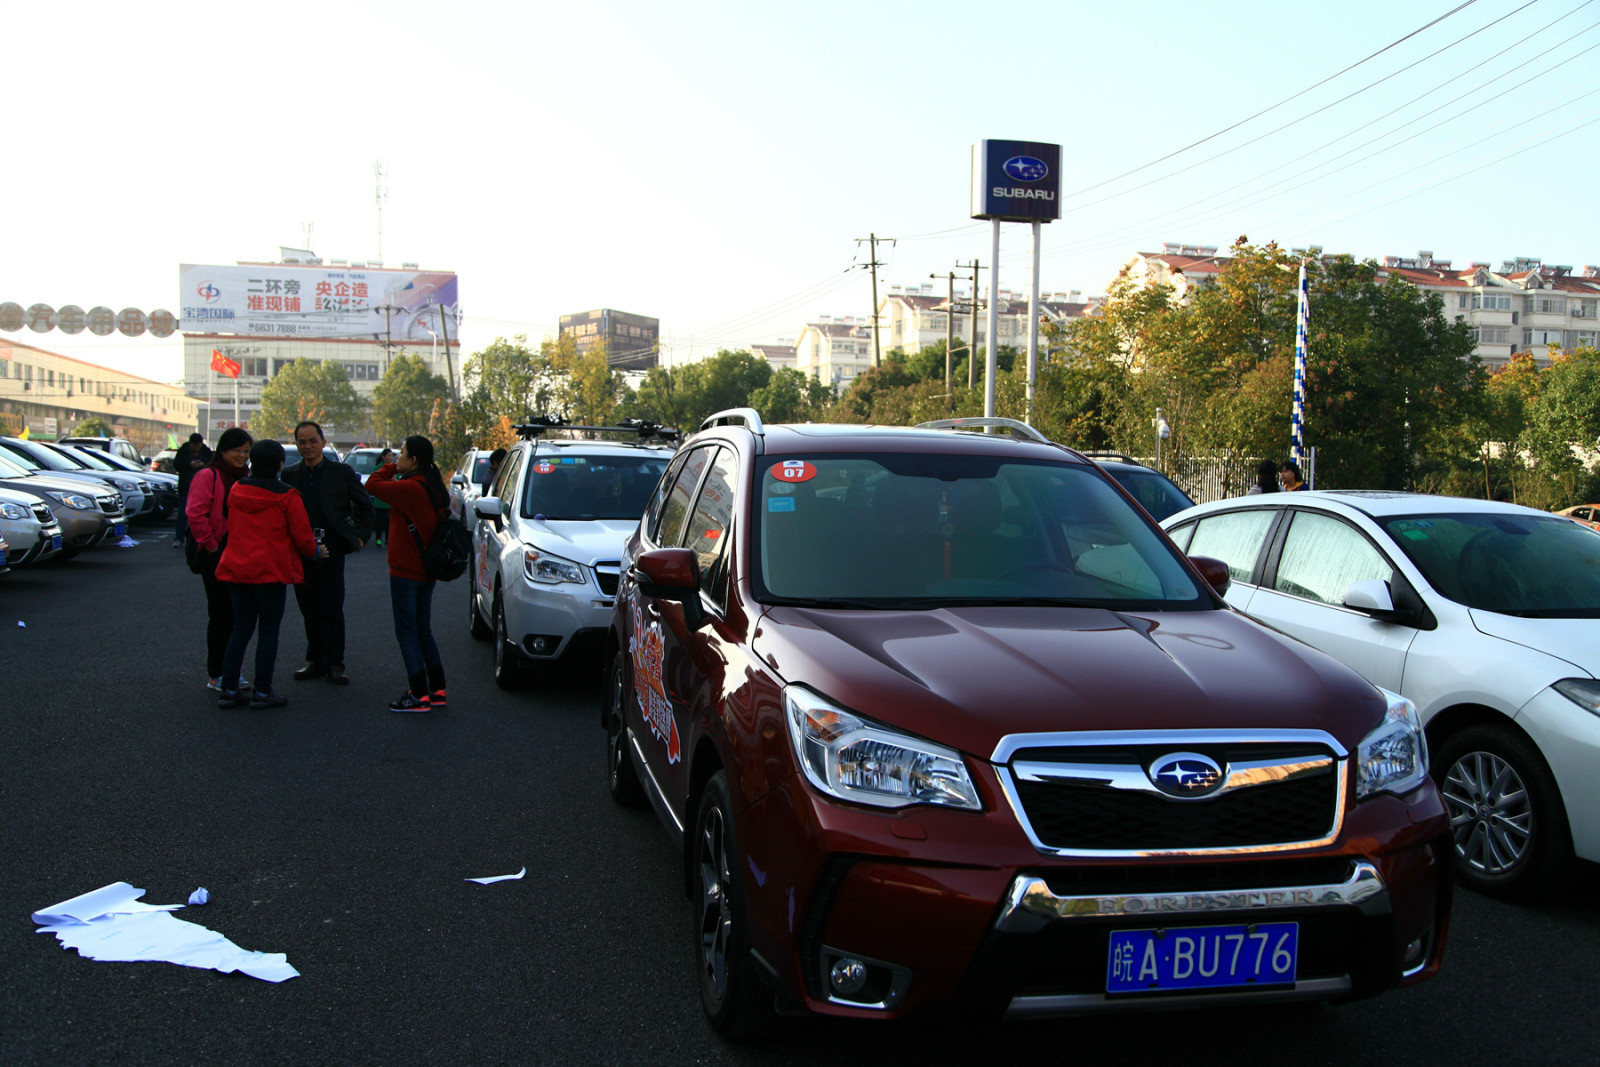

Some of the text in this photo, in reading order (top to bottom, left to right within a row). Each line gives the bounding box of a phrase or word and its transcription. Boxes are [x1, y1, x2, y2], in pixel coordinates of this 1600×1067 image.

[992, 187, 1055, 200] SUBARU
[247, 279, 369, 298] 二环旁 央企造
[247, 295, 301, 312] 准现铺
[184, 307, 235, 319] 宝湾国际
[784, 468, 805, 478] 07
[1096, 889, 1316, 914] FORESTER
